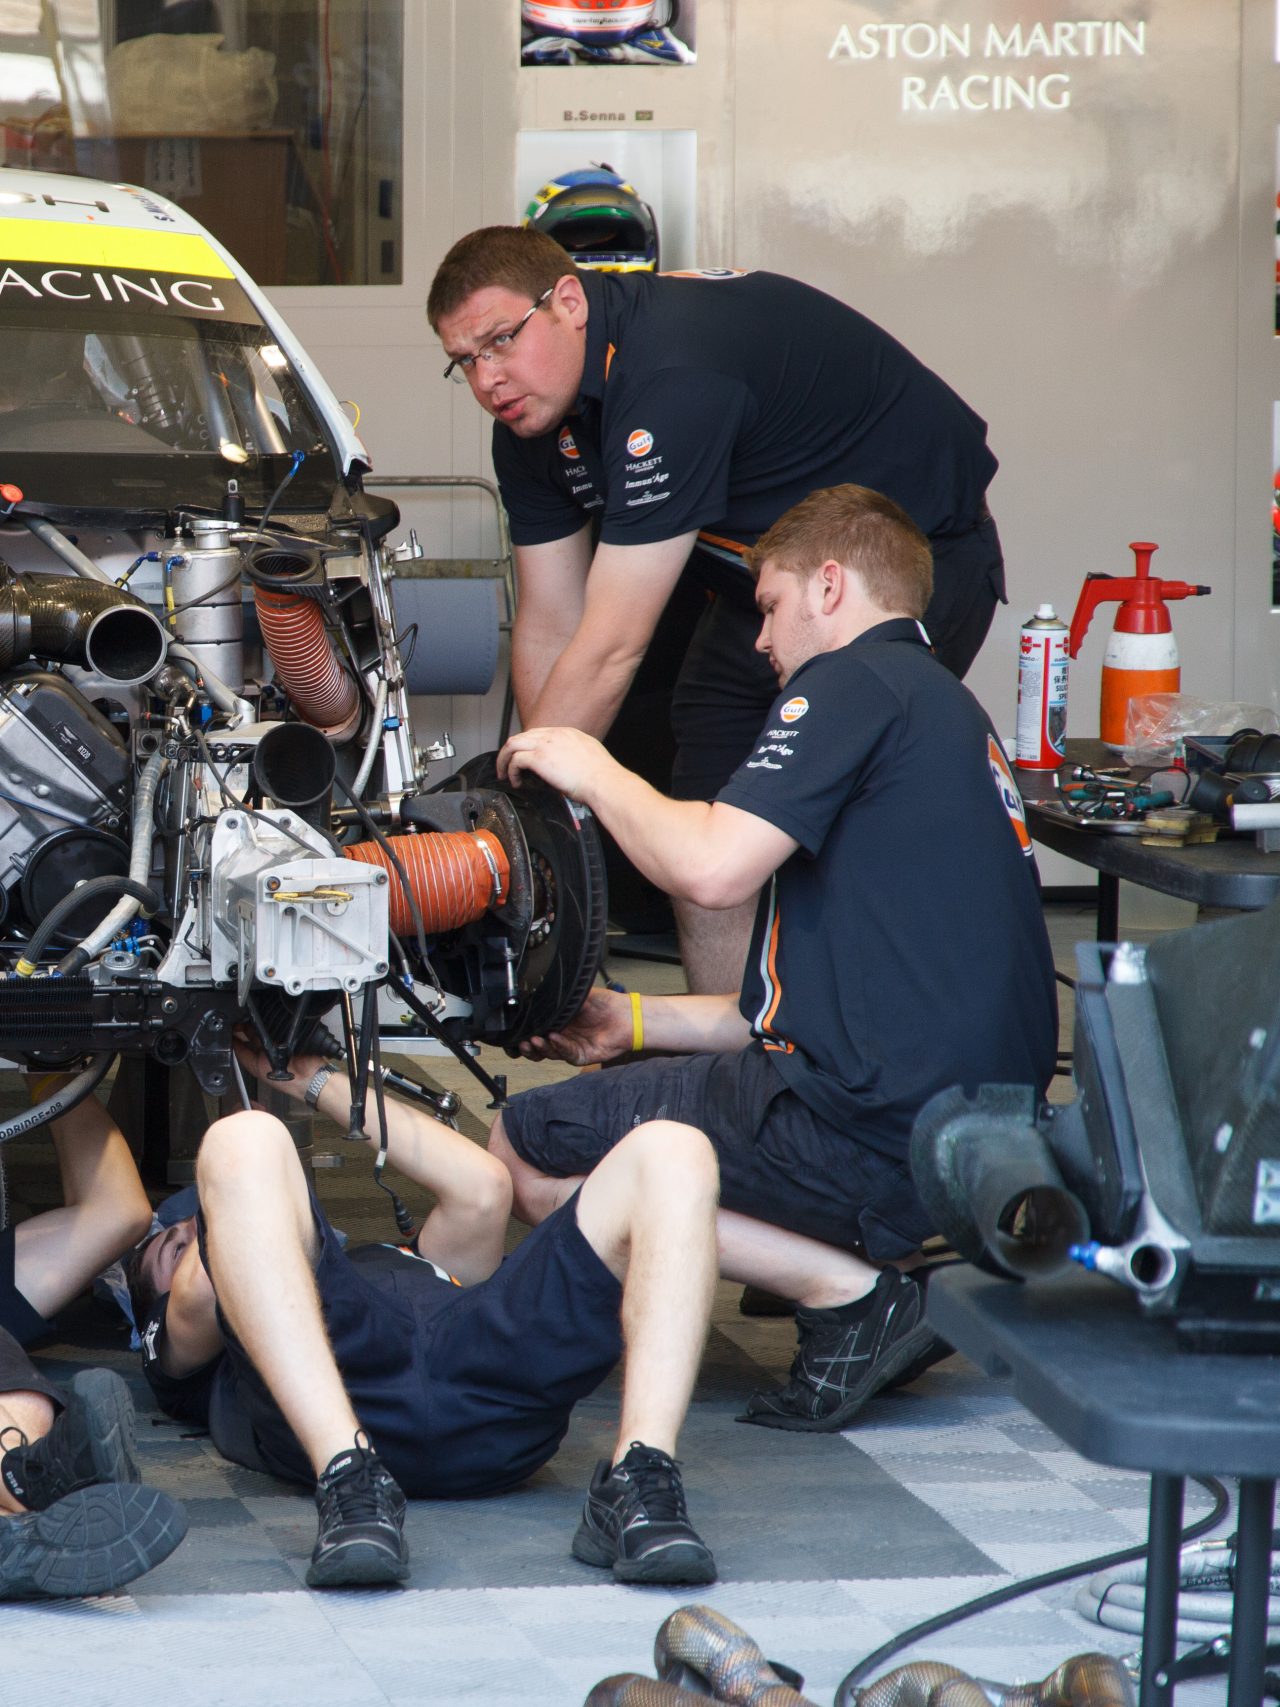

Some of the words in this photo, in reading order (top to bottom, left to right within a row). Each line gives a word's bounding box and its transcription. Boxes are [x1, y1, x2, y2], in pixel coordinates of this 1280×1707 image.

[828, 22, 970, 59] ASTON
[984, 21, 1145, 57] MARTIN
[902, 73, 1070, 110] RACING
[563, 110, 626, 121] B.Senna
[628, 434, 652, 451] Gulf
[625, 456, 663, 472] HACKETT
[784, 705, 806, 713] Gulf
